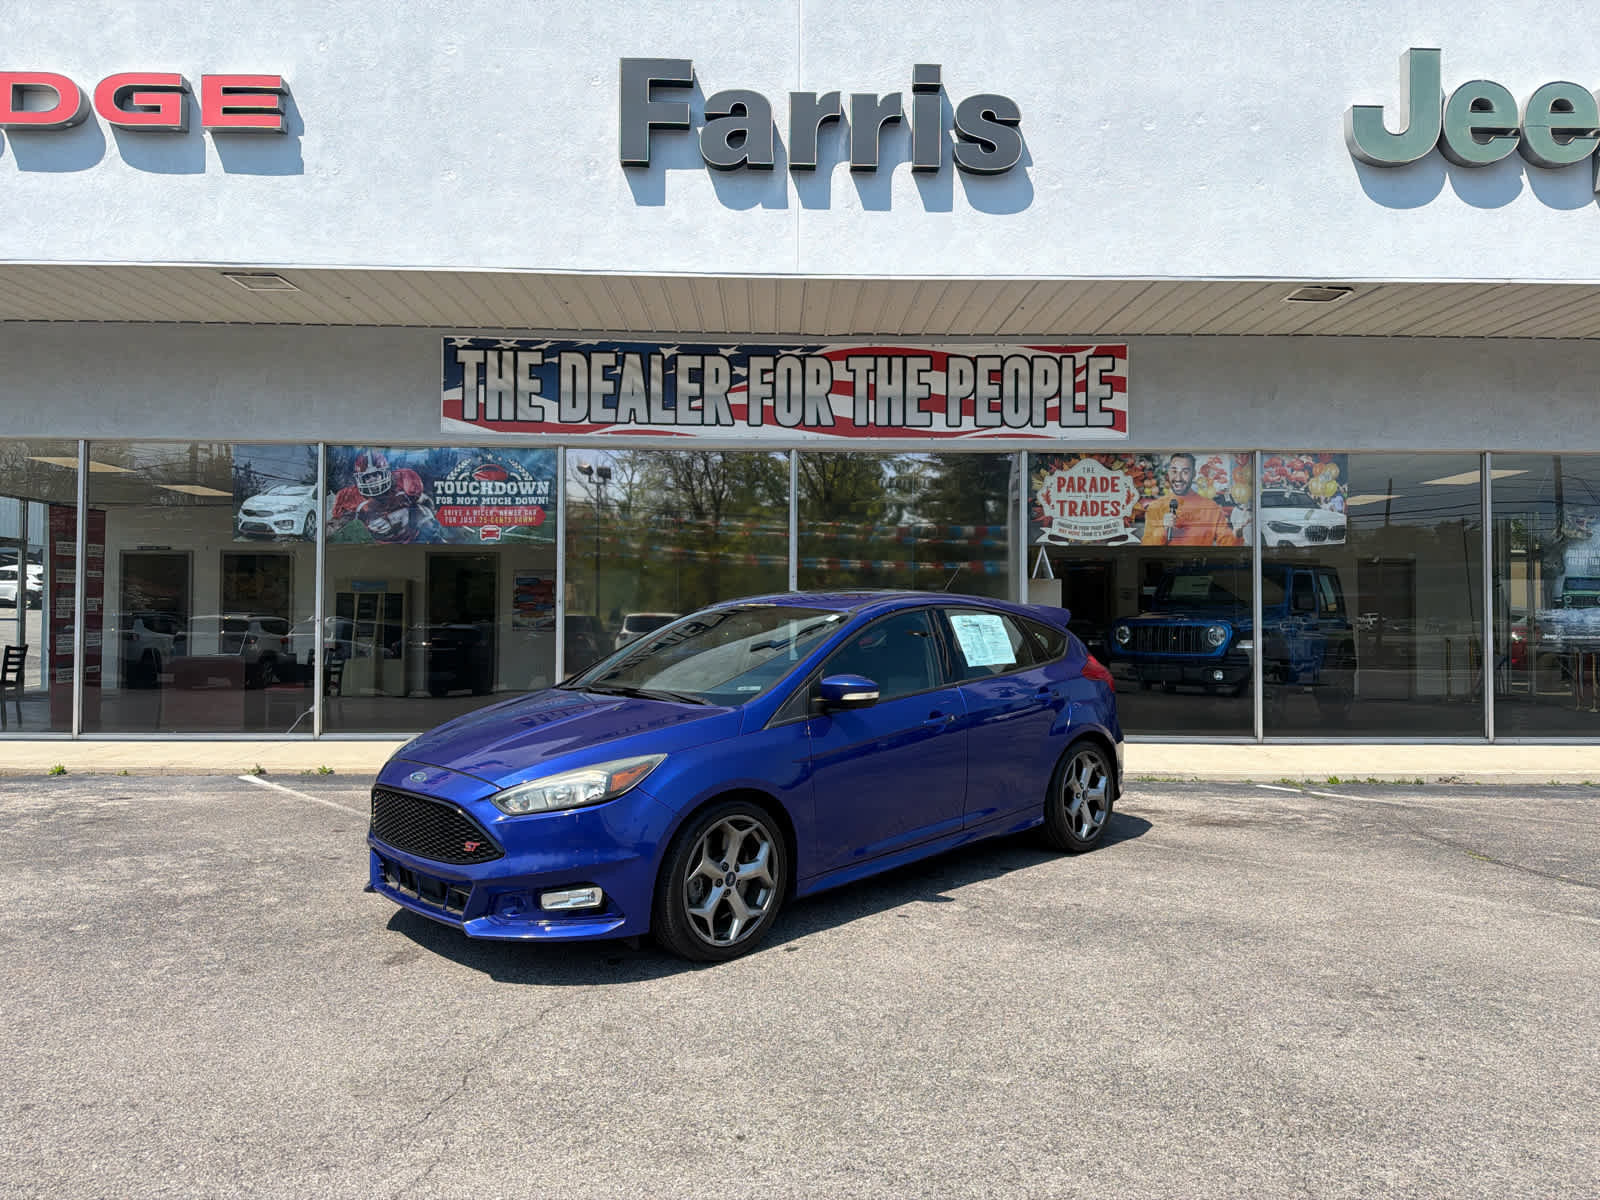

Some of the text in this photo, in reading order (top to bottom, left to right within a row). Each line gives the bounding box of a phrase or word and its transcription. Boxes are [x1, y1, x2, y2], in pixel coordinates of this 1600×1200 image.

[620, 58, 1022, 174] Farris
[1345, 48, 1600, 170] Jee
[456, 350, 1115, 428] THE DEALER FOR THE PEOPLE
[434, 481, 549, 495] TOUCHDOWN
[1056, 476, 1121, 493] PARADE
[436, 496, 549, 505] FOR NOT MUCH DOWN!
[1056, 500, 1121, 517] TRADES
[464, 841, 481, 852] ST
